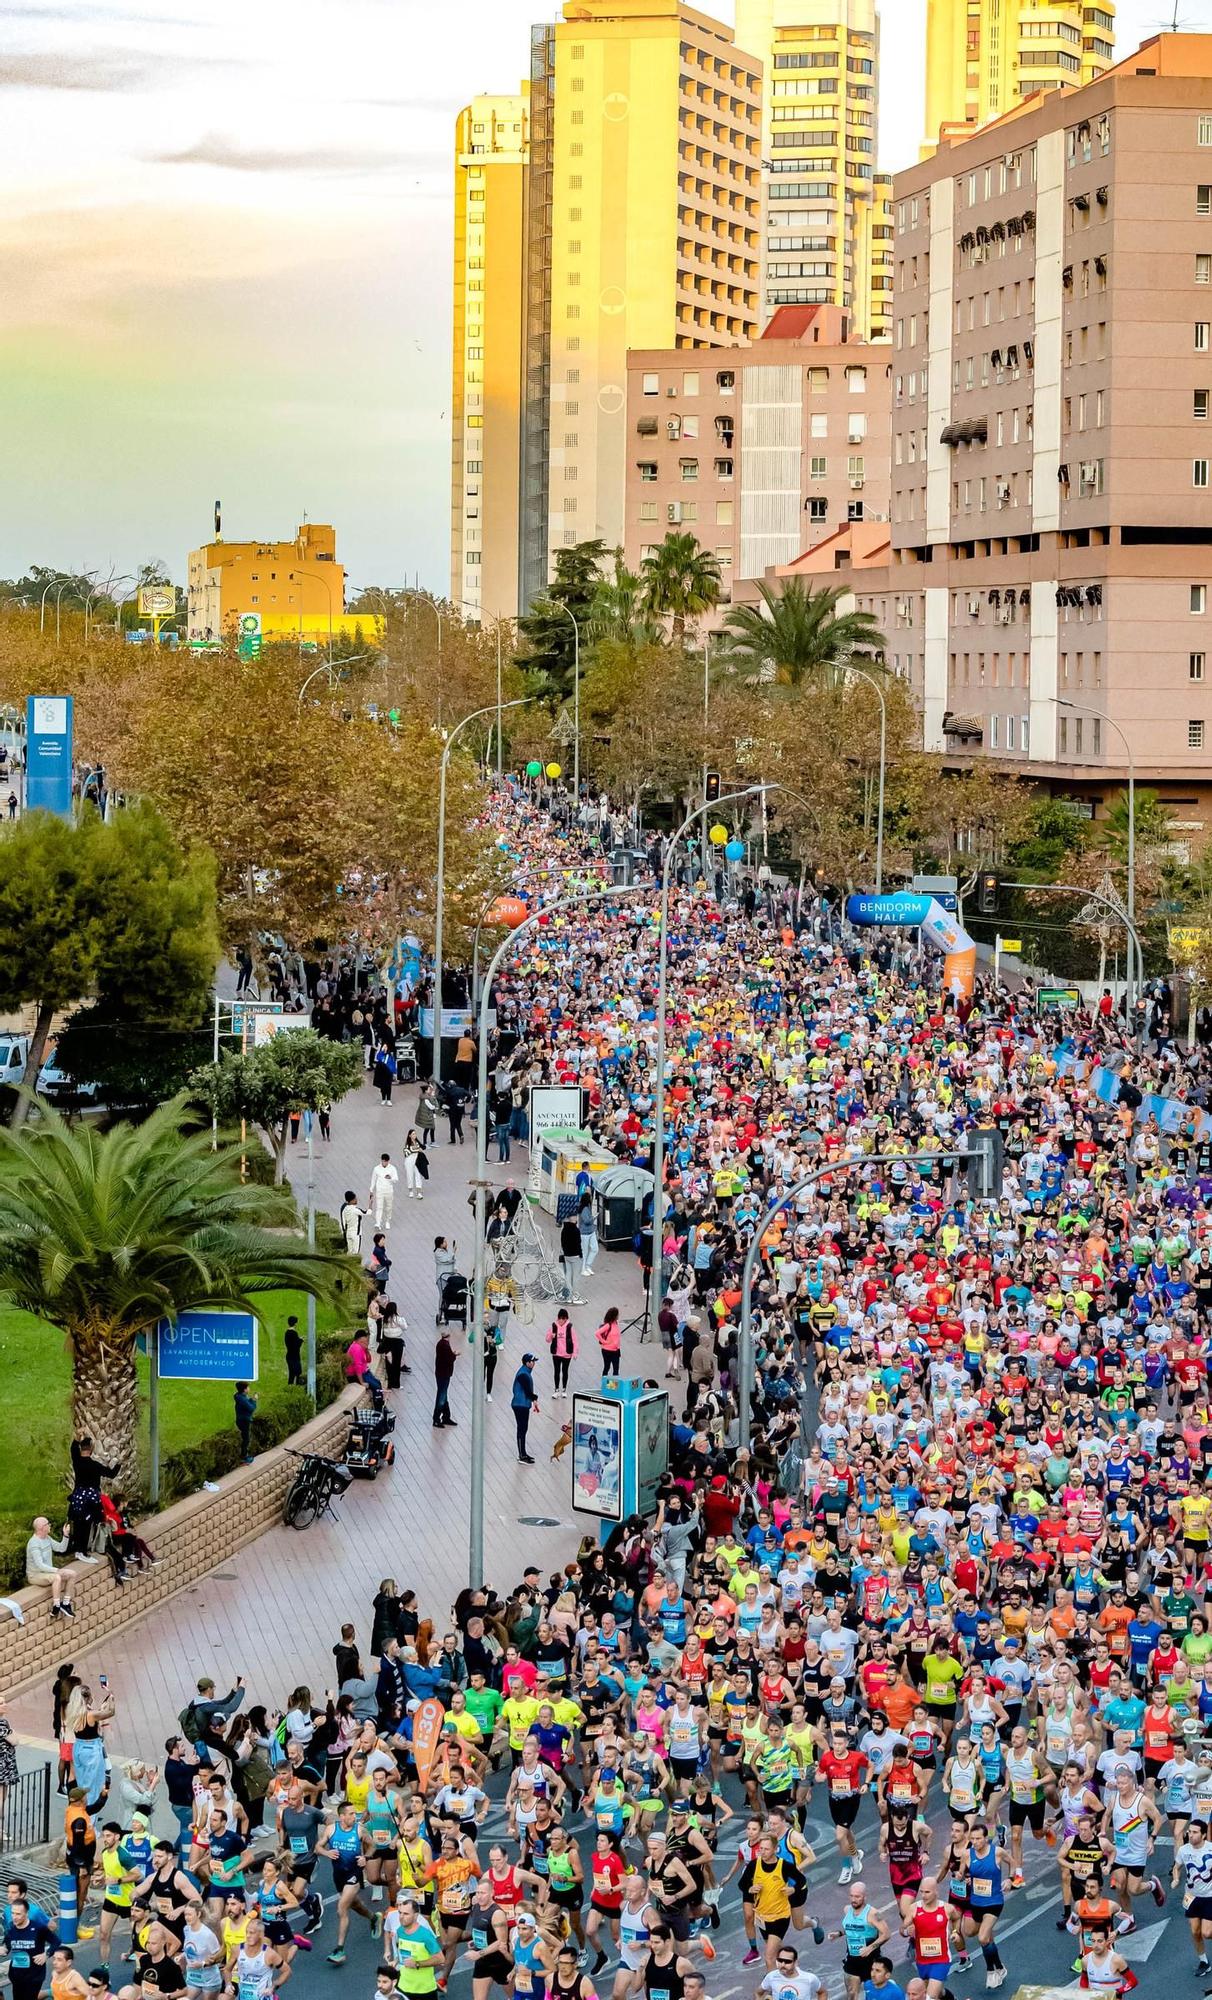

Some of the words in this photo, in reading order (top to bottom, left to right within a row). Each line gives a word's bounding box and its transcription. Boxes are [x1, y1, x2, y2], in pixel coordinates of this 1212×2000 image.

[860, 902, 922, 912] BENIDORM
[874, 913, 905, 922] HALF
[179, 1359, 236, 1367] AUTOSERVICIO
